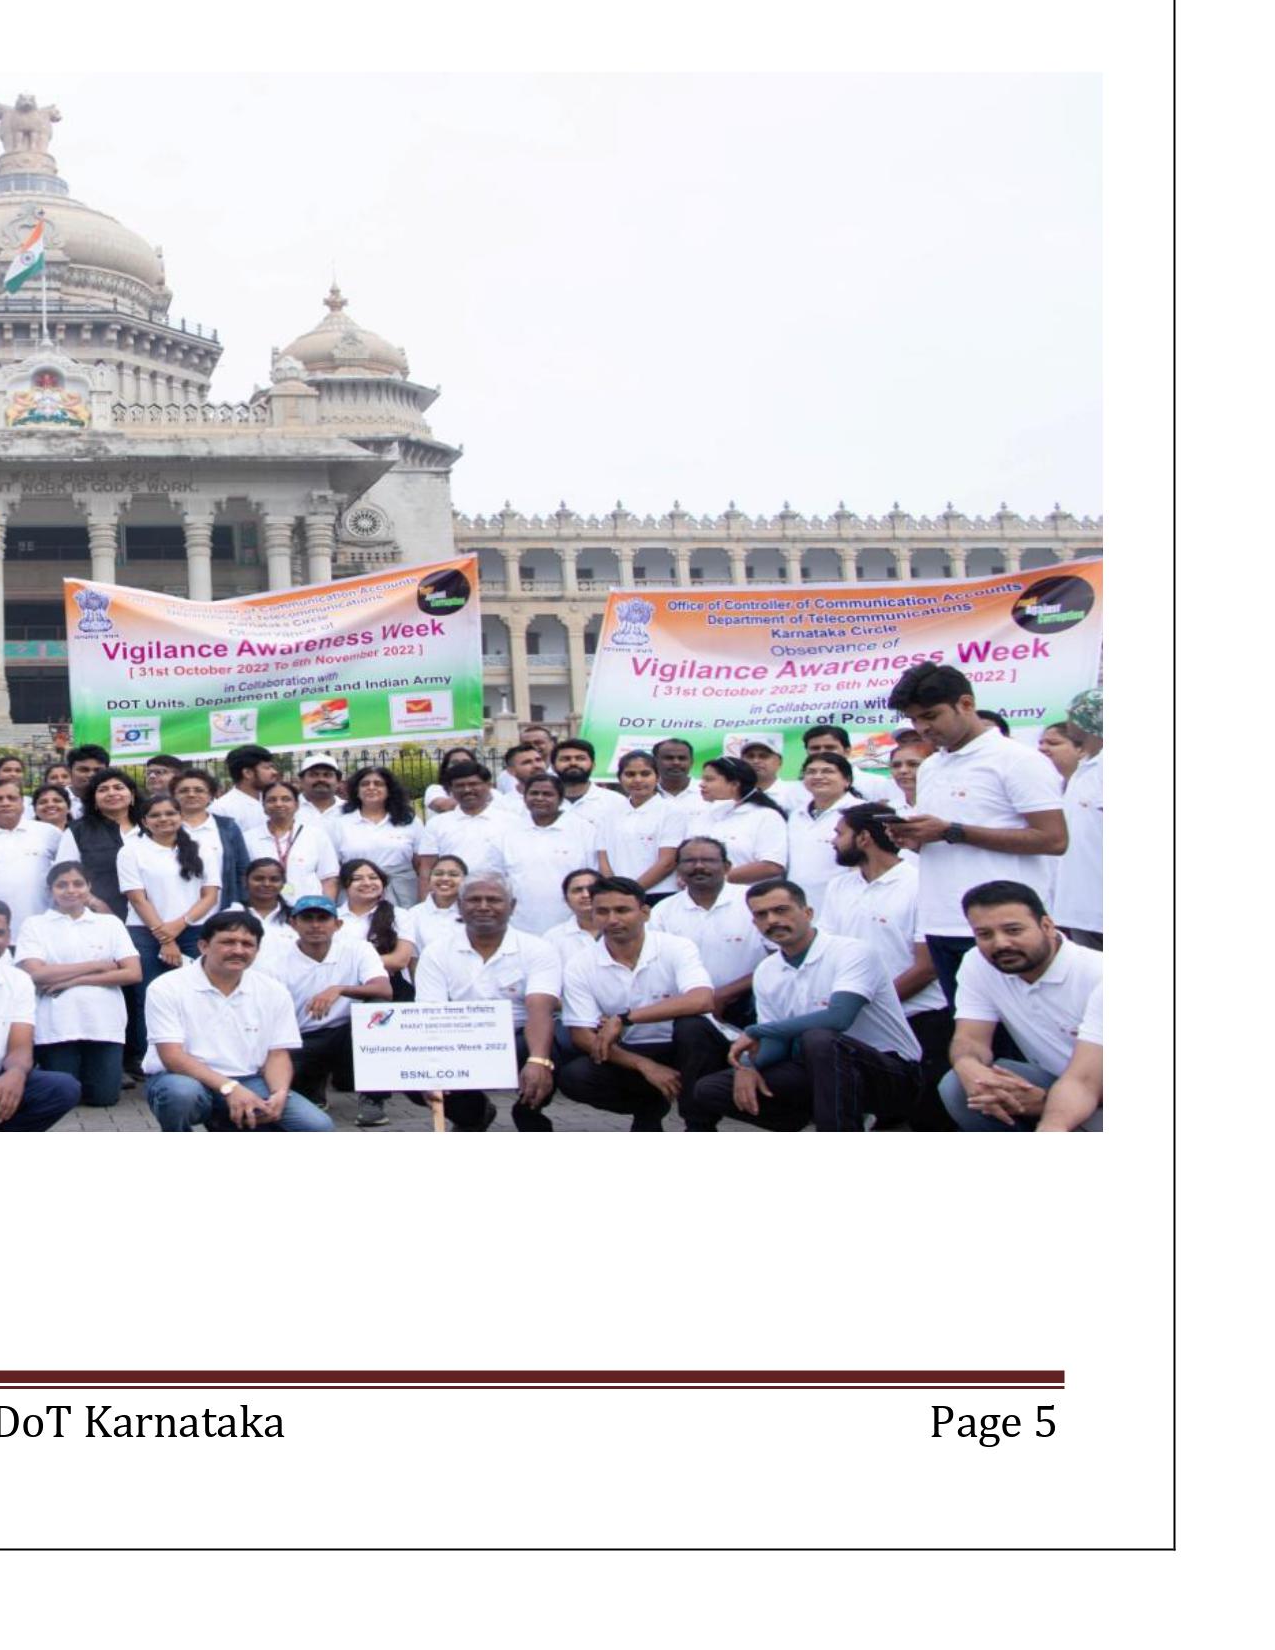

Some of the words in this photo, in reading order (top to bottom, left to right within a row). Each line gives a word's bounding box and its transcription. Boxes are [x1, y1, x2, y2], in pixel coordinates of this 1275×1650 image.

[21, 481, 66, 494] WORK
[73, 481, 88, 494] IS
[90, 481, 139, 494] GOD'S
[359, 576, 419, 595] Accounts
[667, 600, 704, 611] Office
[708, 600, 721, 610] of
[724, 599, 791, 611] Controller
[796, 598, 810, 609] of
[814, 594, 938, 609] Communication
[943, 582, 1023, 602] Accounts
[707, 614, 785, 627] Department
[789, 613, 803, 624] of
[807, 601, 973, 625] Telecommunications
[102, 640, 228, 665] Vigilance
[236, 630, 374, 657] Awareness
[381, 618, 446, 641] Week
[771, 628, 847, 639] Karnataka
[851, 623, 898, 637] Circle
[771, 641, 878, 657] Observance
[882, 637, 901, 648] of
[138, 666, 169, 677] 31st
[174, 664, 233, 677] October
[236, 662, 270, 675] 2022
[274, 661, 289, 672] To
[315, 649, 380, 666] November
[383, 644, 415, 657] 2022
[631, 656, 768, 683] Vigilance
[776, 650, 944, 678] Awareness
[957, 637, 1051, 664] Week
[106, 699, 141, 711] DOT
[195, 690, 279, 708] Department
[283, 689, 298, 700] of
[301, 685, 330, 696] Post
[334, 680, 361, 692] and
[365, 676, 409, 690] Indian
[413, 674, 452, 686] Army
[224, 682, 235, 693] in
[238, 674, 315, 692] Collaboration
[317, 671, 339, 683] with
[663, 686, 697, 697] 31st
[701, 685, 765, 698] October
[769, 683, 808, 696] 2022
[813, 682, 831, 694] To
[835, 680, 861, 692] 6th
[749, 703, 763, 715] in
[766, 697, 860, 715] Collaboration
[863, 696, 887, 710] wit
[619, 716, 656, 728] DOT
[713, 714, 810, 729] Department
[816, 712, 835, 725] of
[841, 712, 884, 725] Post
[997, 707, 1047, 720] Army
[360, 1044, 402, 1054] Vigilance
[405, 1044, 455, 1053] Awareness
[458, 1043, 482, 1052] Week
[485, 1042, 507, 1051] 2022
[400, 1069, 470, 1080] BSNL.CO.IN
[86, 1405, 284, 1437] Karnataka
[932, 1406, 1021, 1447] Page
[1036, 1405, 1055, 1437] 5
